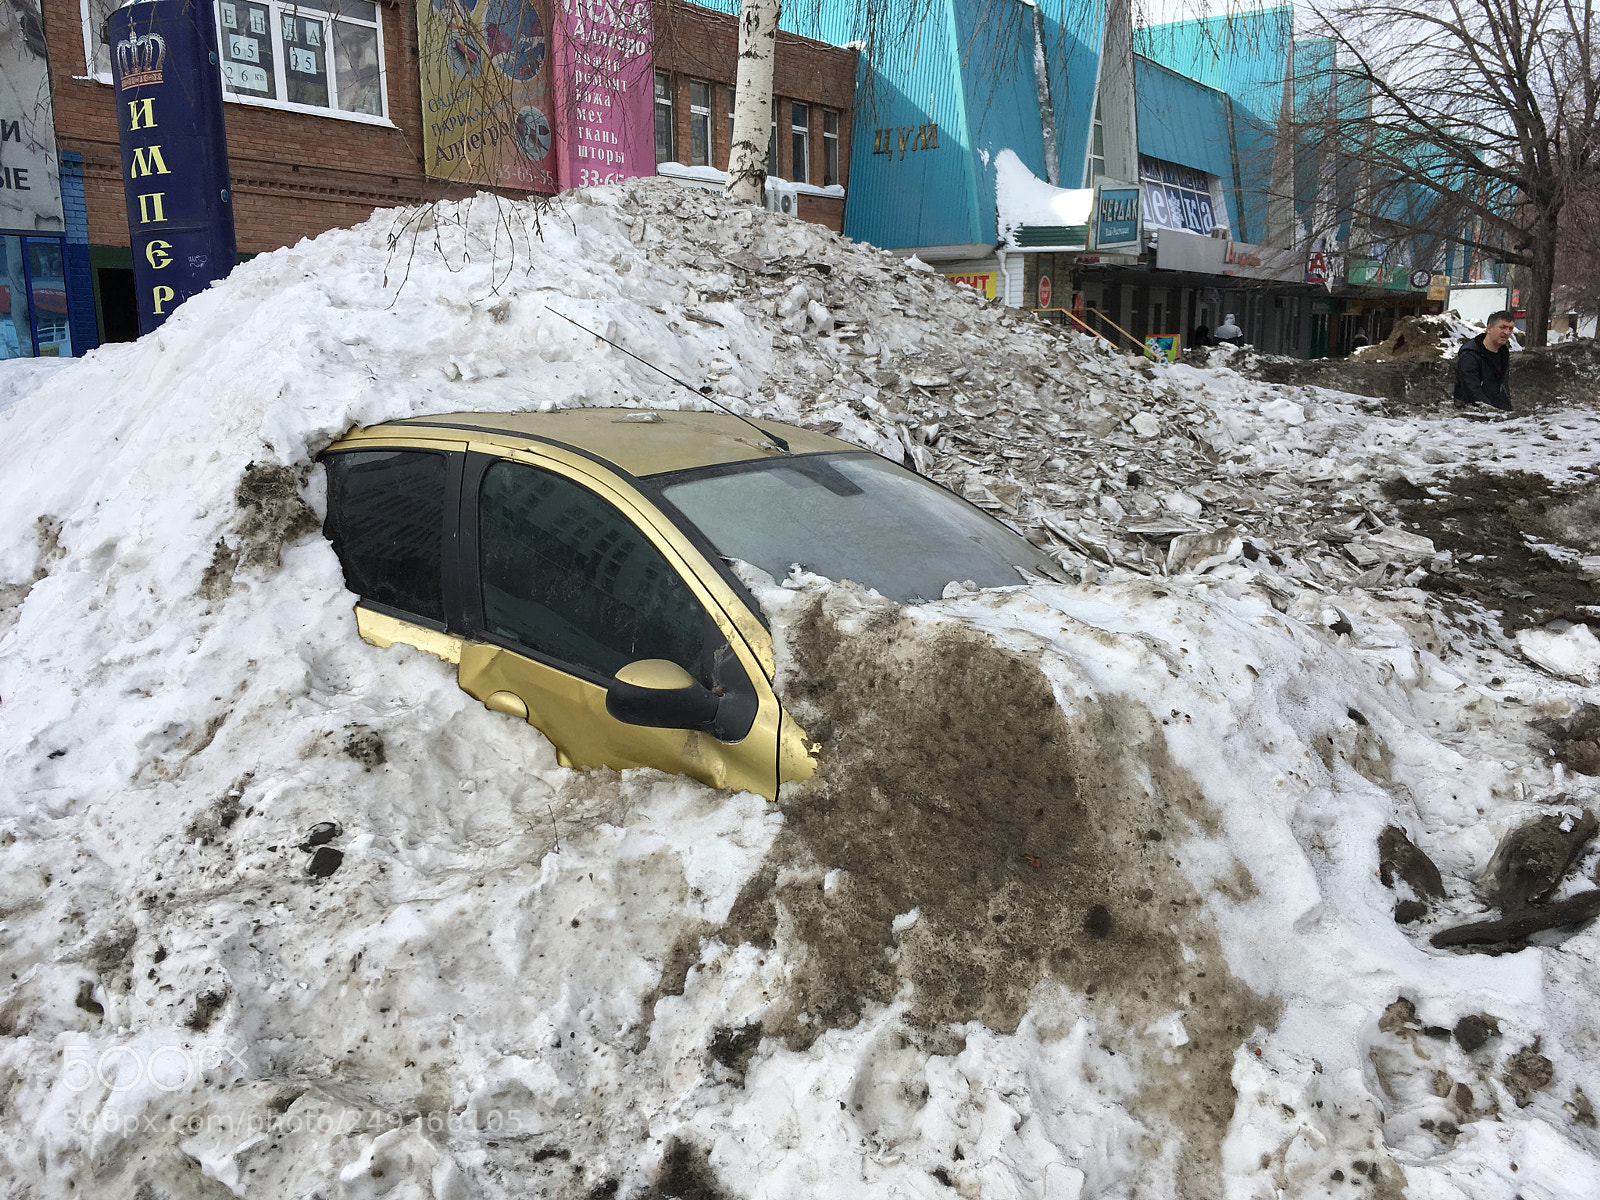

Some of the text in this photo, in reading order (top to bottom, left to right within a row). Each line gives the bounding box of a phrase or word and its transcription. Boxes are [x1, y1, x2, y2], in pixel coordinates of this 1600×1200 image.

[232, 41, 254, 58] 65
[578, 126, 618, 145] ткань
[873, 122, 940, 161] ЦУМ
[578, 145, 625, 165] шторы
[1101, 198, 1138, 222] ЧЕРДАК
